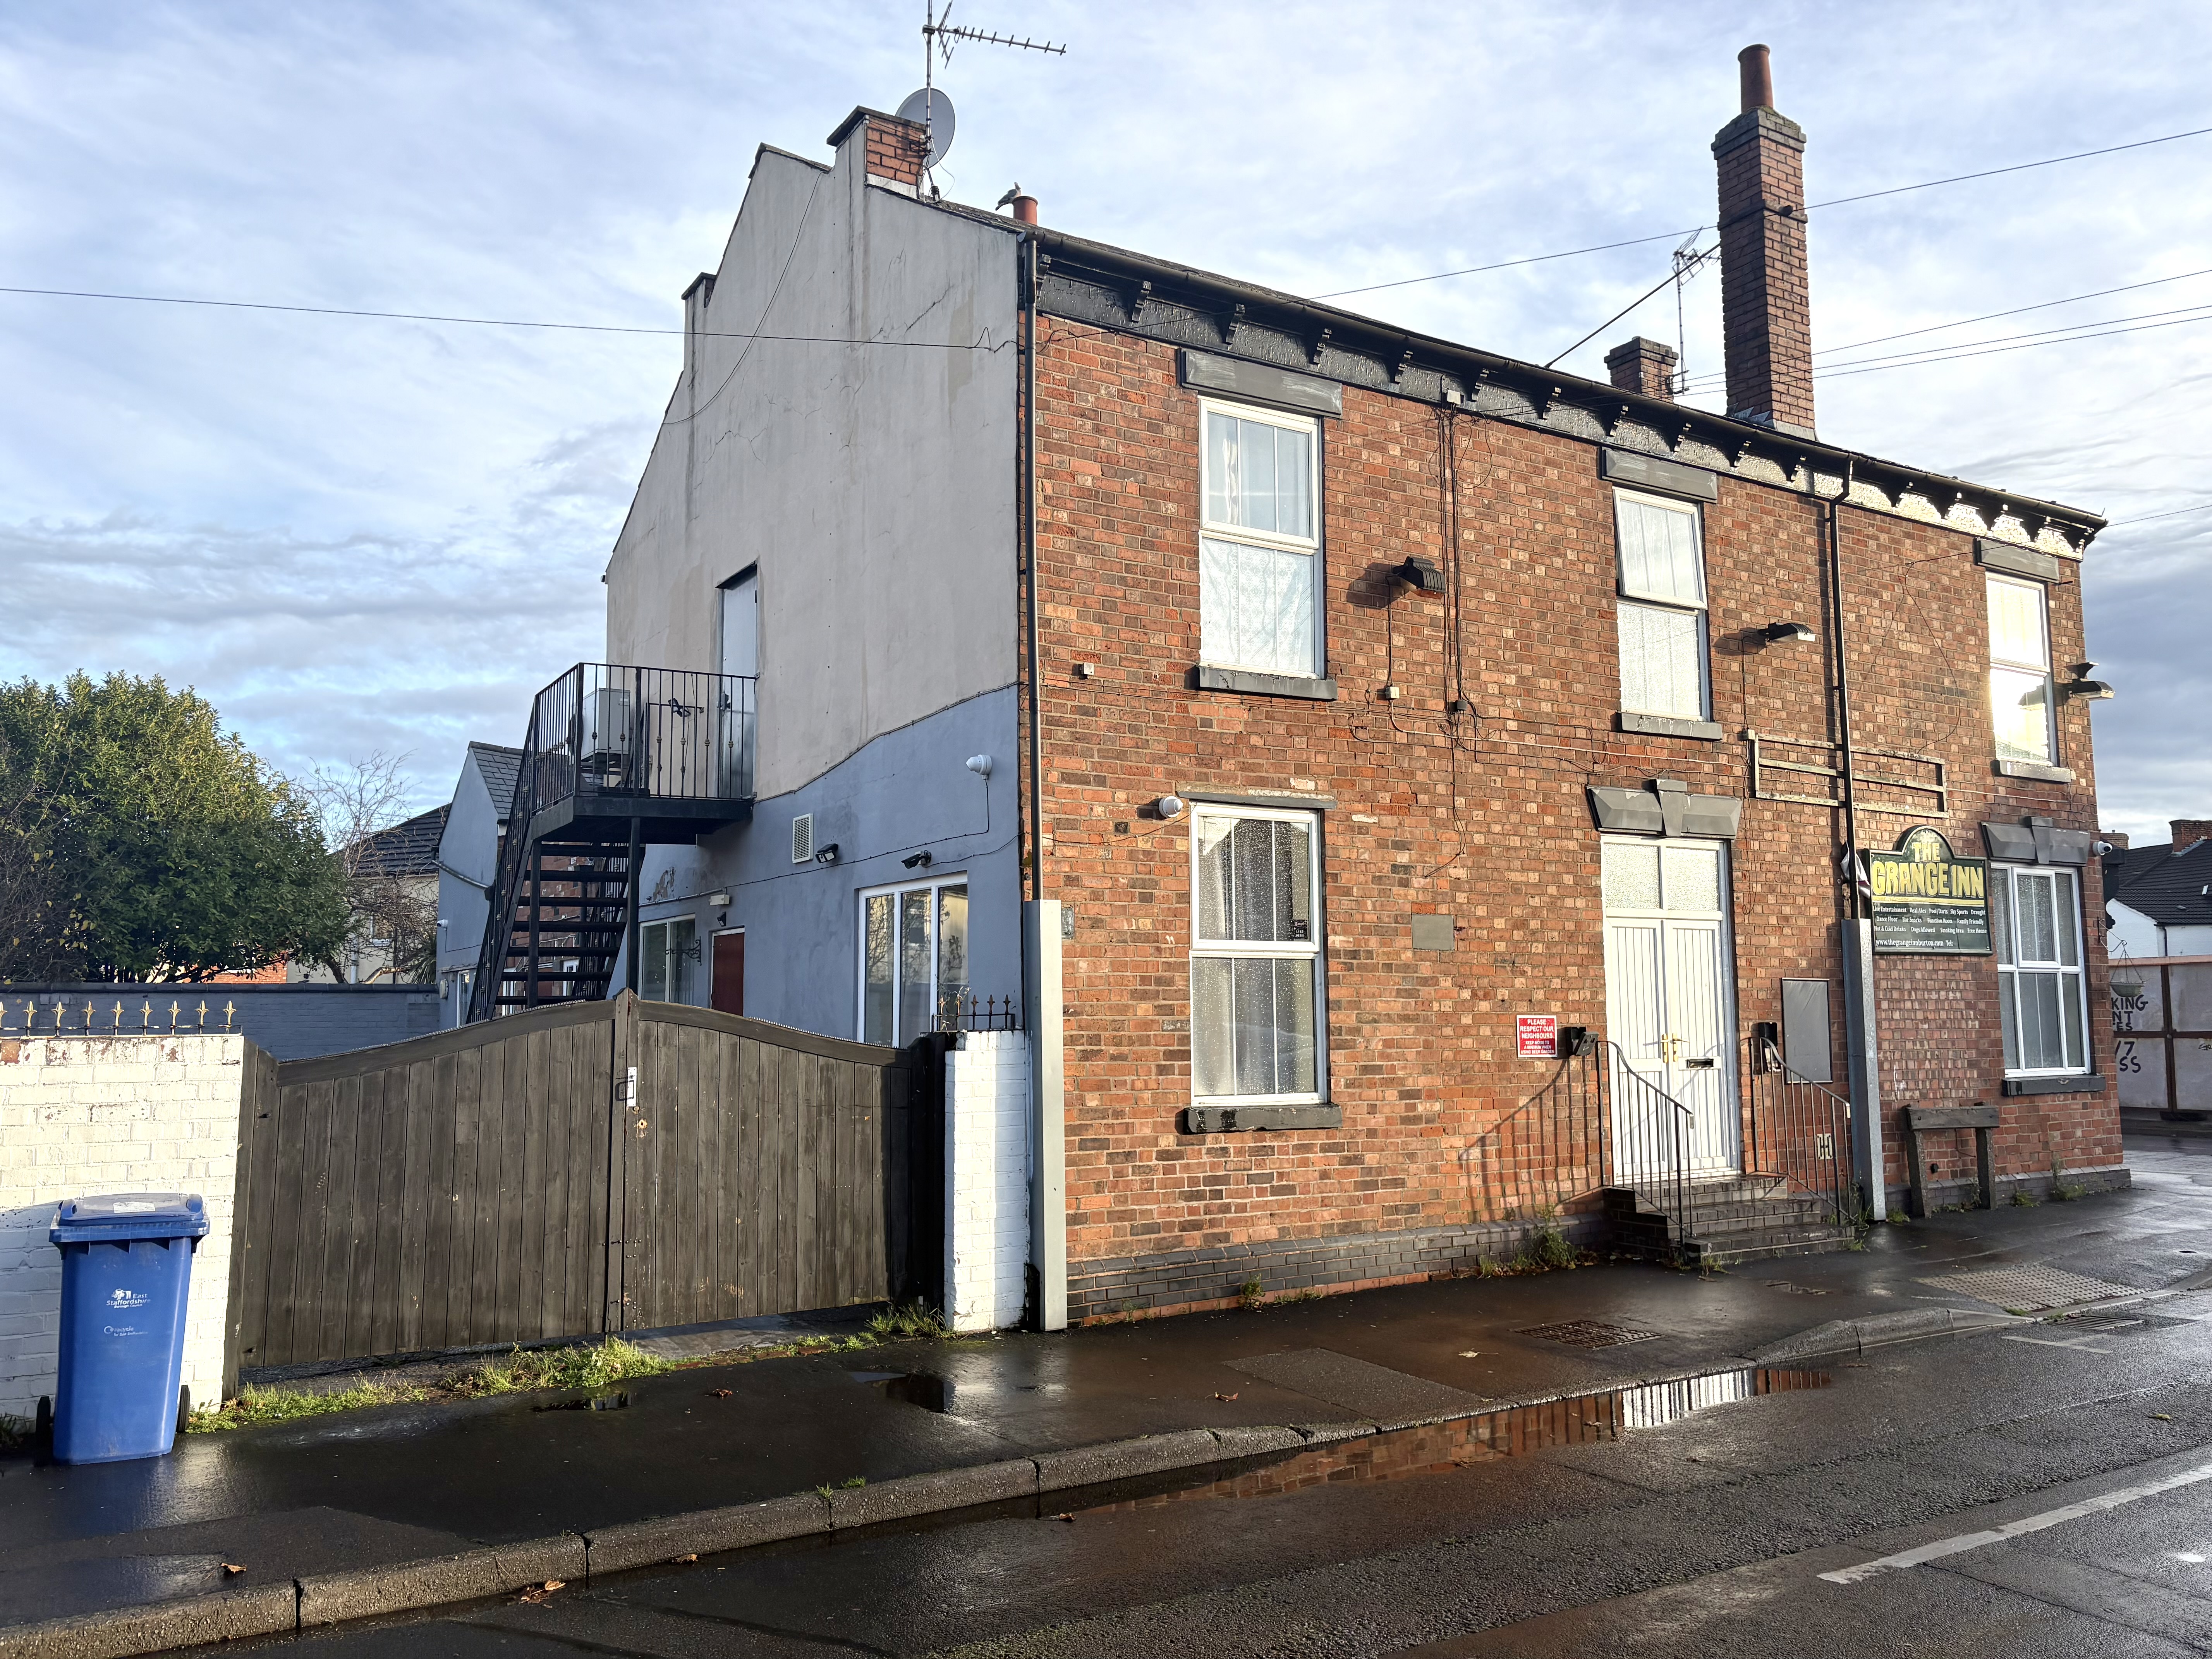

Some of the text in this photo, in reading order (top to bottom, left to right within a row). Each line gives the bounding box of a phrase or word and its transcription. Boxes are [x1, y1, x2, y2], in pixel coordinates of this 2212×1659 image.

[1912, 842, 1940, 862] THE
[1871, 860, 1984, 898] GRANGE INN
[1875, 938, 1944, 947] www.thegrangeinnburton.com
[2112, 1022, 2133, 1031] ES
